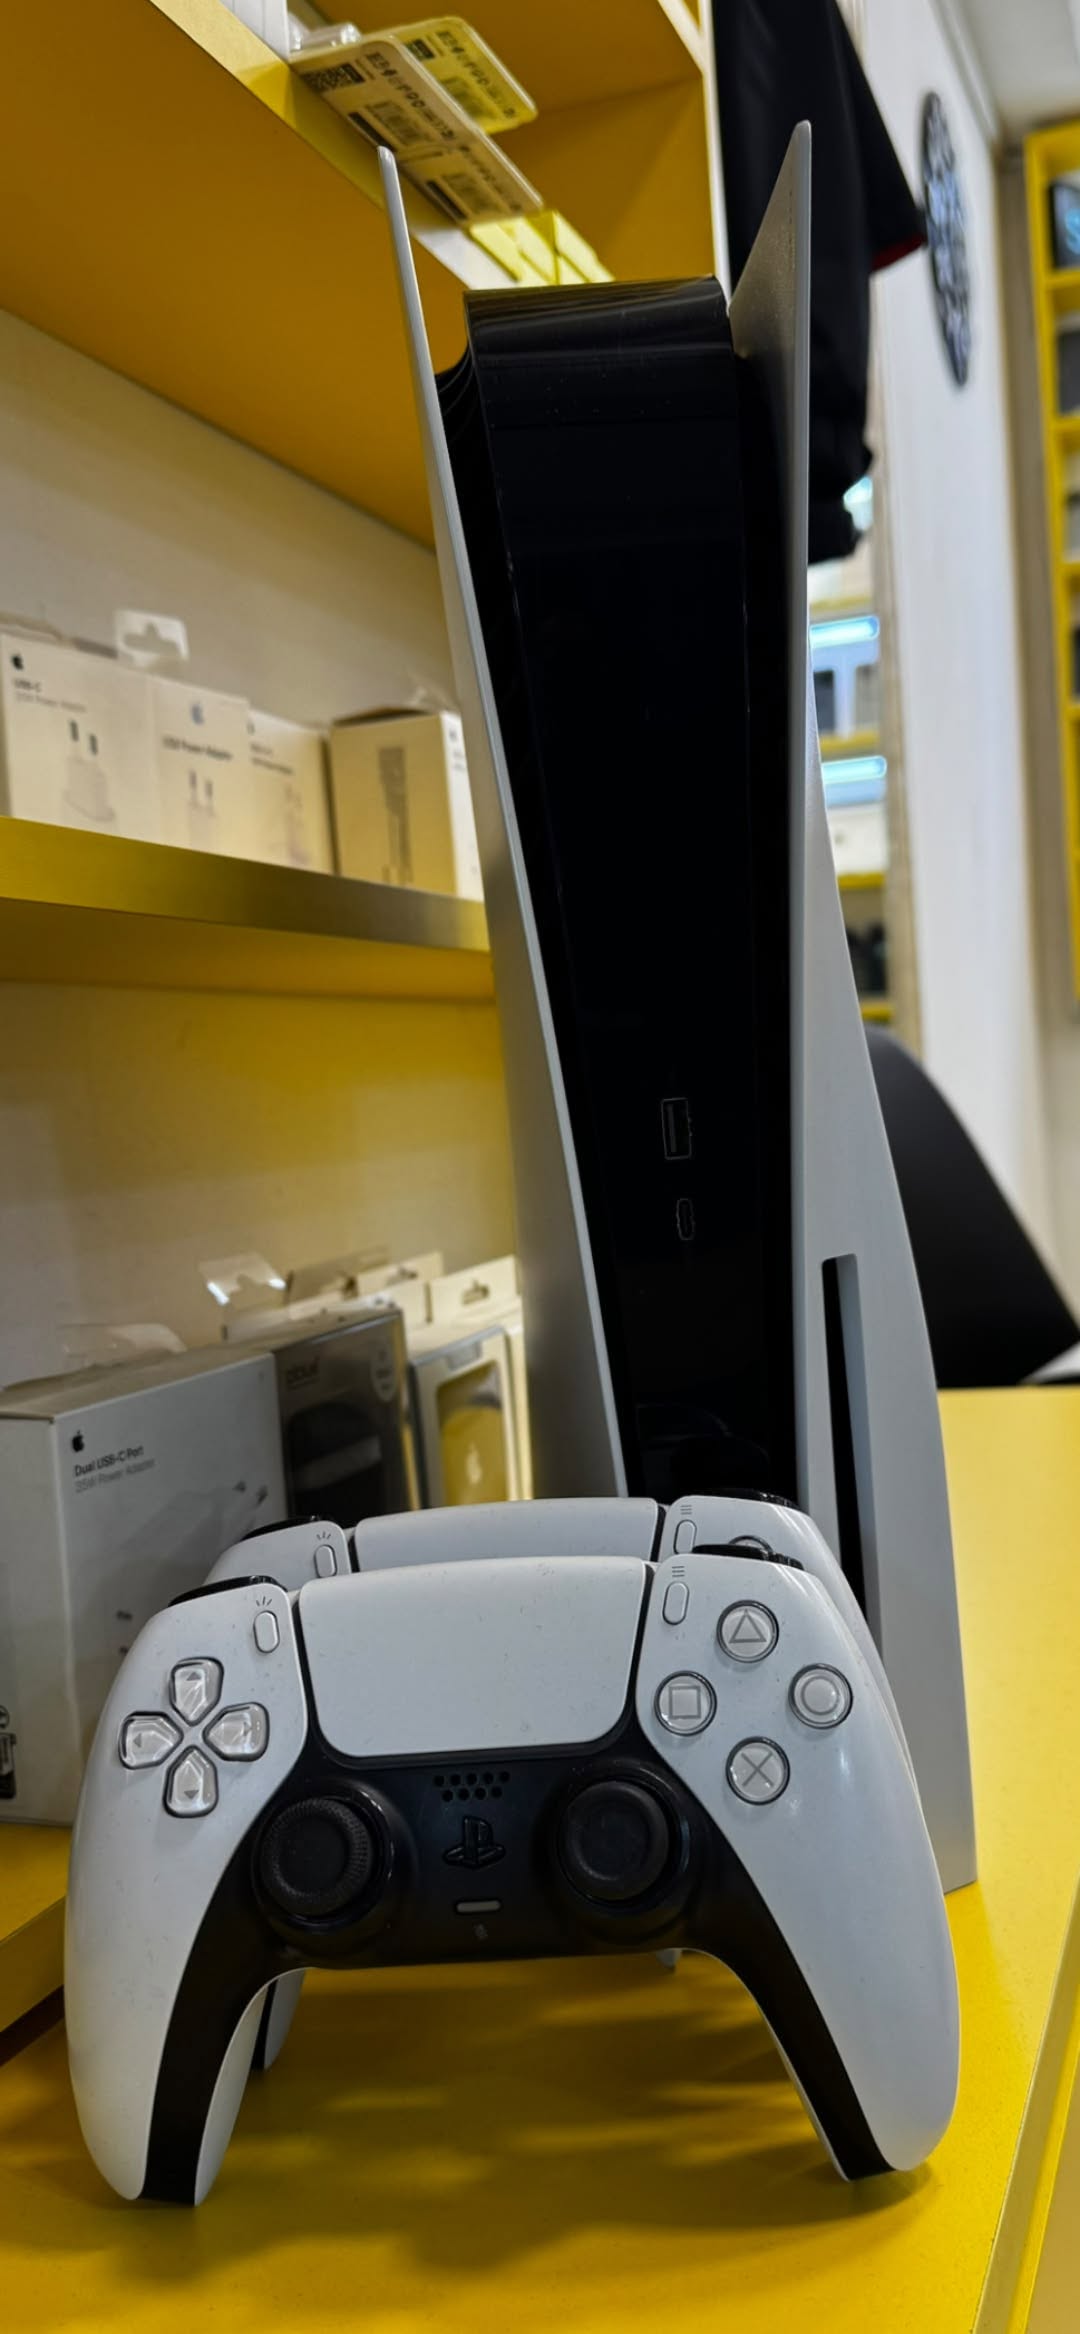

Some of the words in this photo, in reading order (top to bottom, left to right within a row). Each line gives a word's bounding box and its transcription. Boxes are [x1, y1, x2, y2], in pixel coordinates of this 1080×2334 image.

[75, 1460, 96, 1477] Dual
[97, 1450, 126, 1469] USB-C
[126, 1445, 144, 1459] Port
